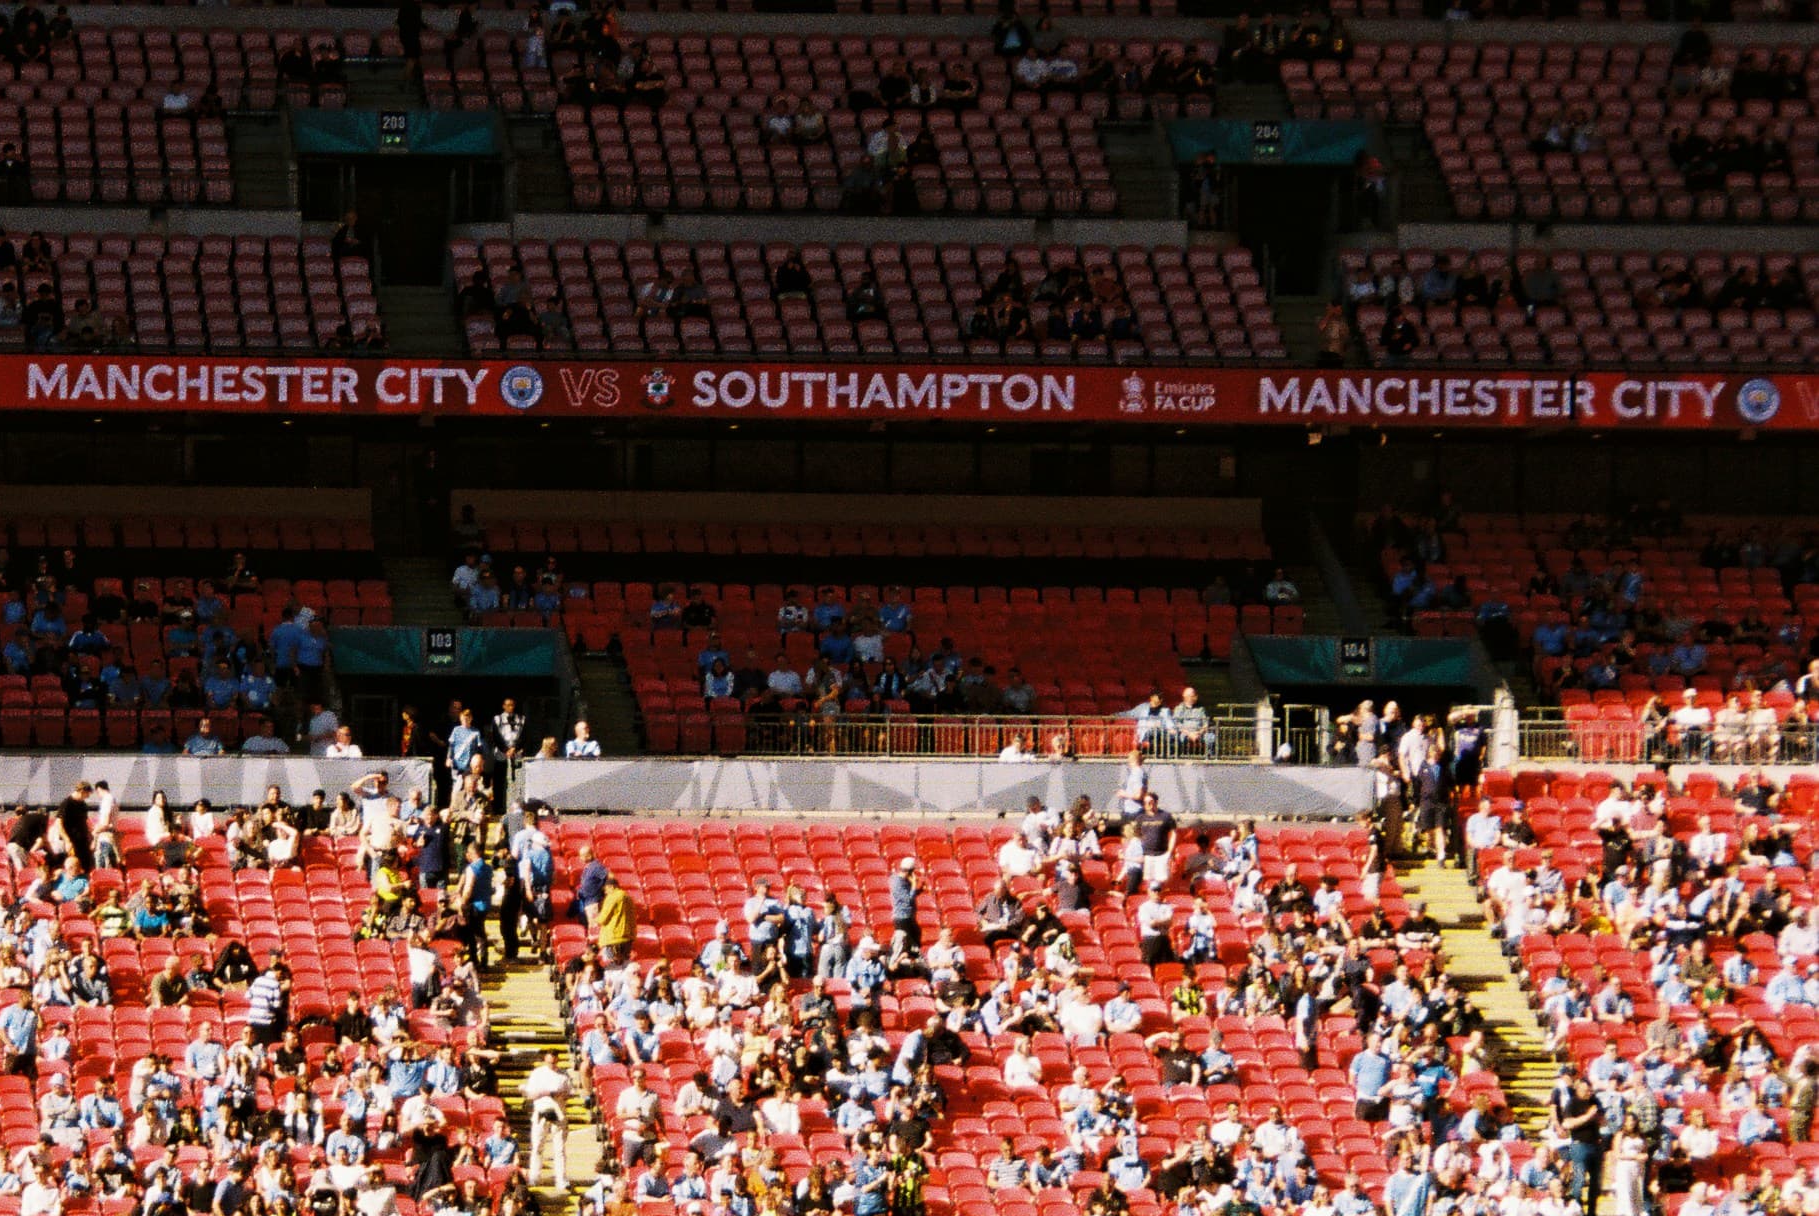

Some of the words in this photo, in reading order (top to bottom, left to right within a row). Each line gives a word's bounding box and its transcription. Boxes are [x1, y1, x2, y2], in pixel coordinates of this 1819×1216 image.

[382, 115, 406, 130] 203
[1255, 124, 1279, 139] 204
[27, 362, 360, 403] MANCHESTER
[375, 366, 489, 405] CITY
[559, 367, 621, 408] VS
[692, 370, 1076, 411] SOUTHAMPTON
[1154, 381, 1216, 395] Emirates
[1154, 395, 1177, 411] FA
[1178, 395, 1217, 412] CUP
[1259, 376, 1597, 417] MANCHESTER
[1612, 380, 1726, 419] CITY
[429, 633, 453, 648] 103
[1343, 642, 1367, 657] 104
